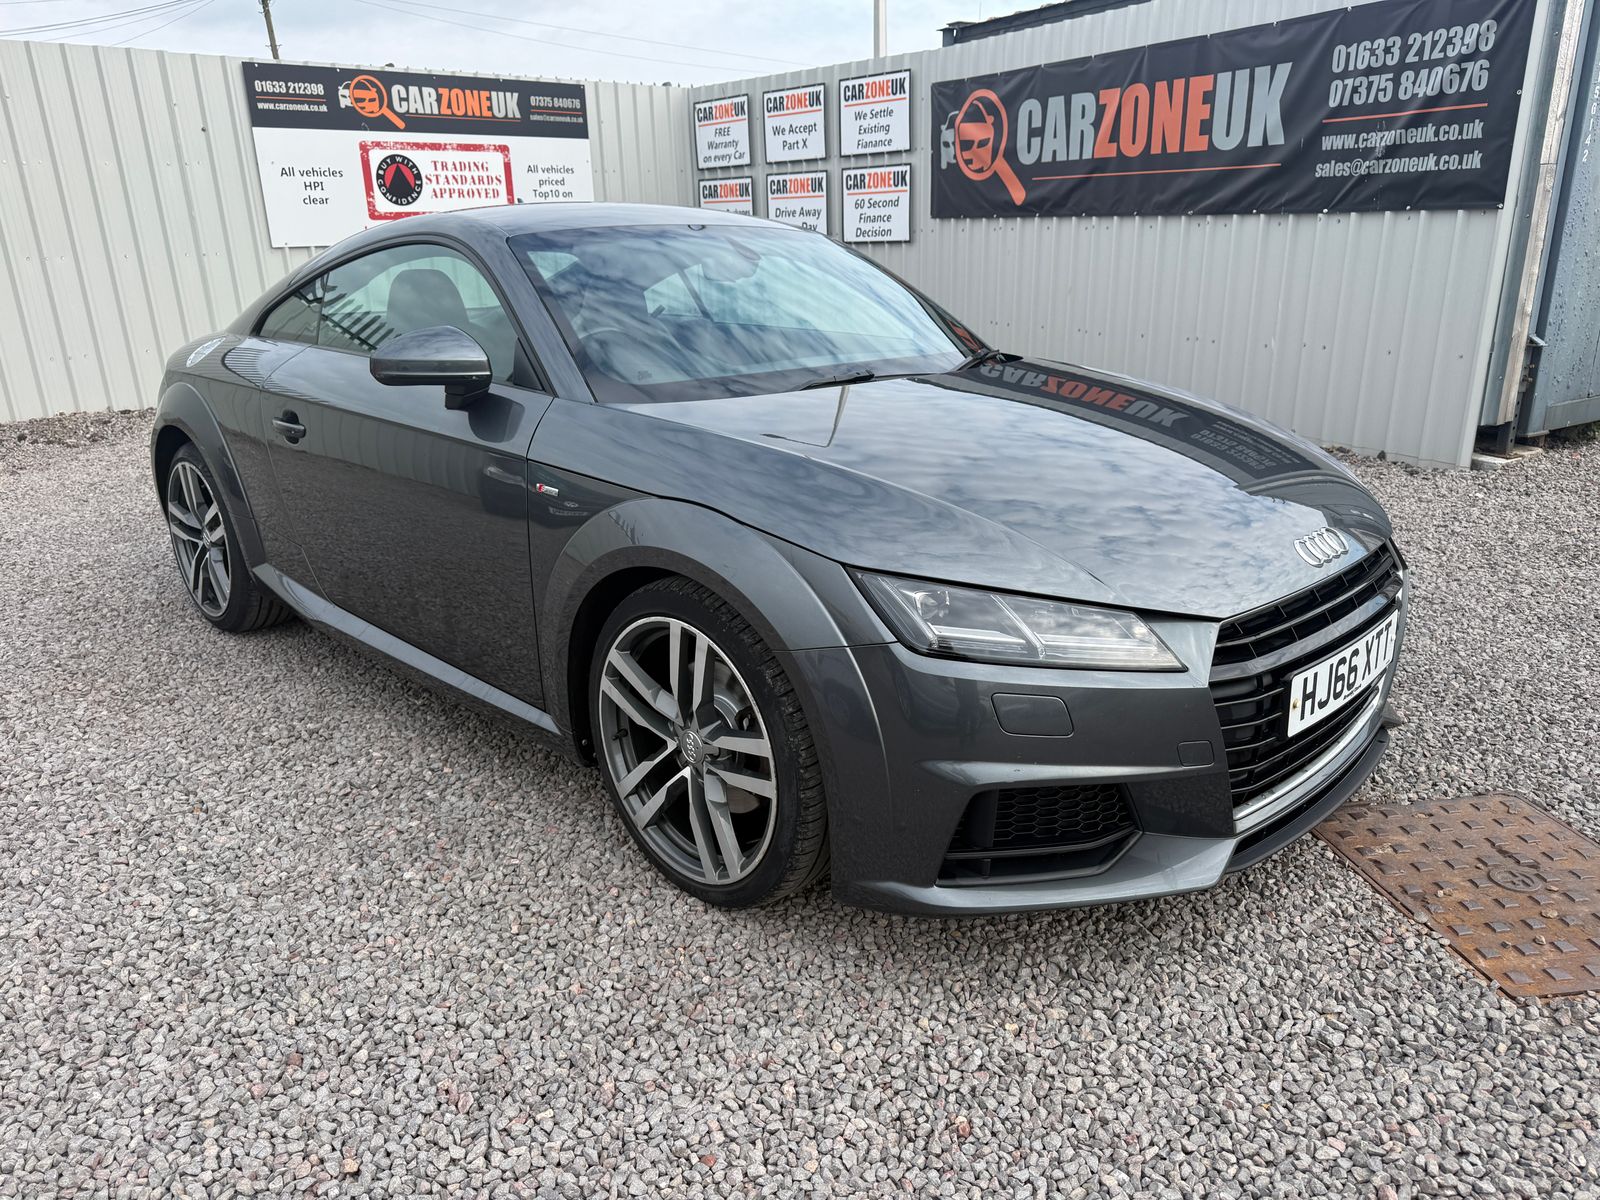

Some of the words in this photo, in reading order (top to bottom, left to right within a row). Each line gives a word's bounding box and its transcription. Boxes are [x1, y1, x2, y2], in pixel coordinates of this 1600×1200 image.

[1332, 36, 1401, 73] 01633
[1405, 20, 1497, 64] 212398
[254, 80, 287, 94] 01633
[288, 81, 325, 96] 212398
[843, 77, 906, 103] CARZONEUK
[1328, 72, 1394, 108] 07375
[1398, 59, 1490, 101] 840676
[256, 102, 328, 113] www.carzoneuk.co.uk
[391, 84, 521, 119] CARZONEUK
[530, 95, 552, 107] 07375
[553, 97, 581, 109] 840676
[766, 90, 822, 113] CARZONEUK
[696, 100, 747, 123] CARZONEUK
[854, 110, 868, 121] We
[869, 108, 894, 119] Settle
[1016, 61, 1294, 166] CARZONEUK
[714, 126, 732, 137] FREE
[772, 124, 787, 137] We
[788, 122, 818, 135] Accept
[858, 123, 891, 136] Existing
[1322, 119, 1485, 151] www.carzoneuk.co.uk
[707, 138, 740, 151] Warranty
[782, 139, 800, 151] Part
[801, 138, 809, 149] X
[856, 137, 893, 150] Fianance
[713, 153, 733, 163] every
[733, 151, 746, 161] Car
[378, 157, 393, 176] BUY
[395, 155, 419, 176] WITH
[430, 160, 489, 172] TRADING
[526, 164, 540, 174] All
[541, 165, 575, 175] vehicles
[1315, 150, 1483, 178] sales@carzoneuk.co.uk
[280, 166, 296, 178] All
[298, 166, 344, 179] vehicles
[303, 180, 325, 192] HPI
[424, 173, 503, 186] STANDARDS
[538, 177, 566, 189] priced
[769, 177, 824, 195] CARZONEUK
[845, 170, 908, 191] CARZONEUK
[377, 178, 422, 206] CONFIDENCE
[430, 187, 500, 199] APPROVED
[533, 189, 561, 200] Top10
[562, 190, 574, 199] on
[702, 182, 750, 200] CARZONEUK
[302, 194, 330, 206] clear
[854, 198, 866, 210] 60
[867, 196, 900, 209] Second
[775, 207, 797, 218] Drive
[798, 206, 822, 220] Away
[858, 213, 892, 224] Finance
[801, 222, 818, 232] Day
[855, 227, 892, 238] Decision
[1299, 647, 1360, 722] HJ66
[1362, 619, 1393, 682] XTT
